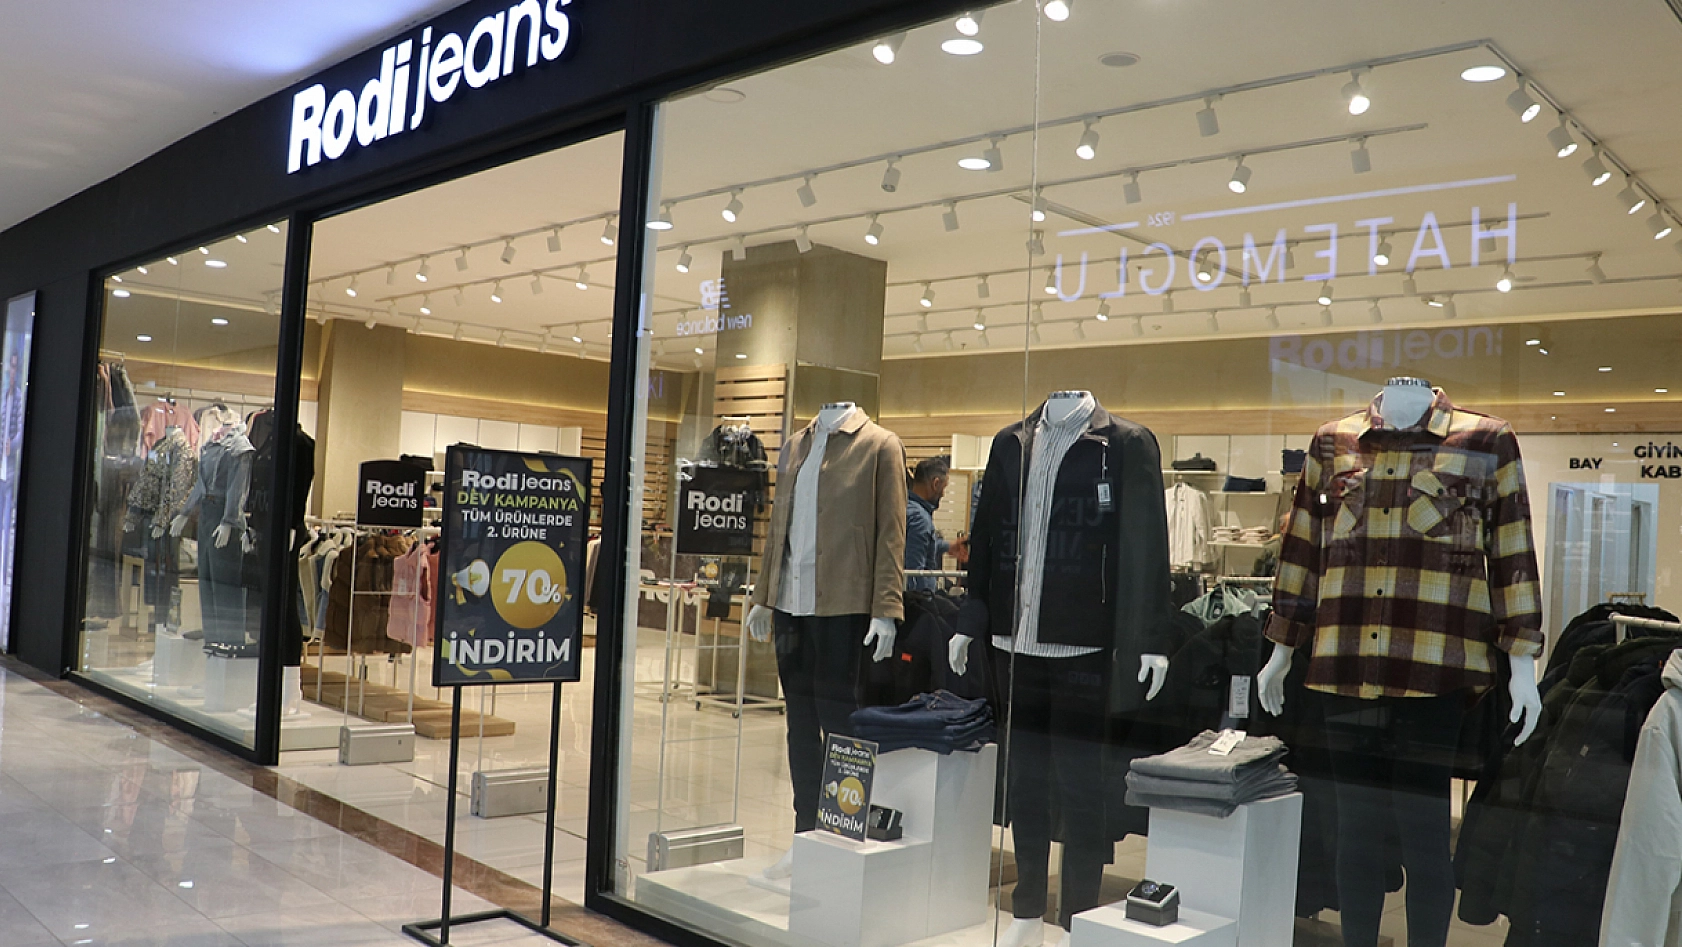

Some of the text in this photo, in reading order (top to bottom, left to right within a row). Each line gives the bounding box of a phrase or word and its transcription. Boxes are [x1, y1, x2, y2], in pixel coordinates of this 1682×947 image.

[287, 0, 571, 174] Rodi jeans
[1569, 457, 1603, 470] BAY
[366, 480, 414, 497] Rodi
[462, 470, 571, 491] Rodi jeans
[371, 494, 417, 509] jeans
[456, 491, 578, 511] DEV KAMPANYA
[687, 490, 743, 513] Rodi
[461, 508, 573, 527] TÜM ÜRÜNLERDE
[693, 510, 747, 531] jeans
[487, 525, 547, 540] 2. ÜRÜNE
[502, 569, 561, 604] 70%
[448, 631, 570, 665] İNDİRİM
[821, 808, 864, 833] İNDİRİM
